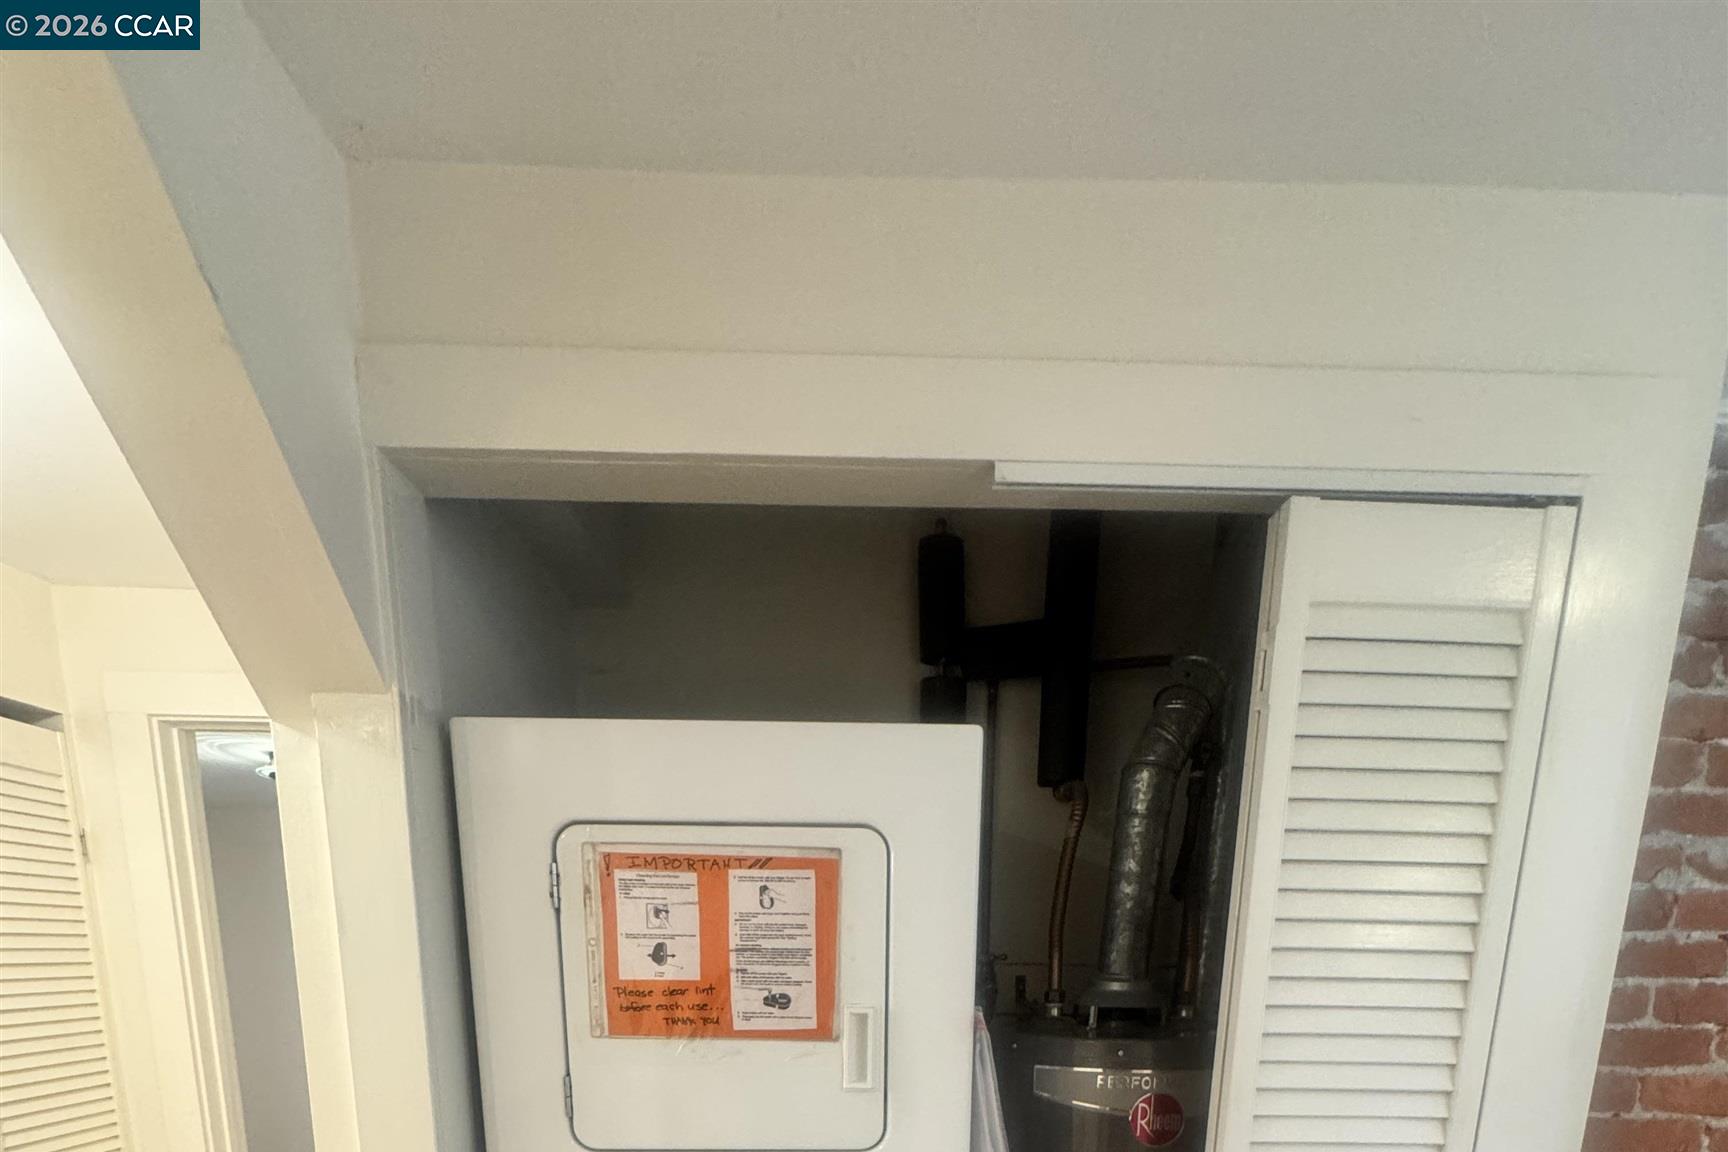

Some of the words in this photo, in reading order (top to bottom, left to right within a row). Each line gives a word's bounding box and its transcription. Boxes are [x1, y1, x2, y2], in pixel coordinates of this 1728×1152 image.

[612, 985, 655, 999] Please
[661, 985, 690, 998] clear
[655, 1001, 685, 1012] each
[699, 1016, 721, 1027] YOU
[1136, 1094, 1182, 1138] Rheem
